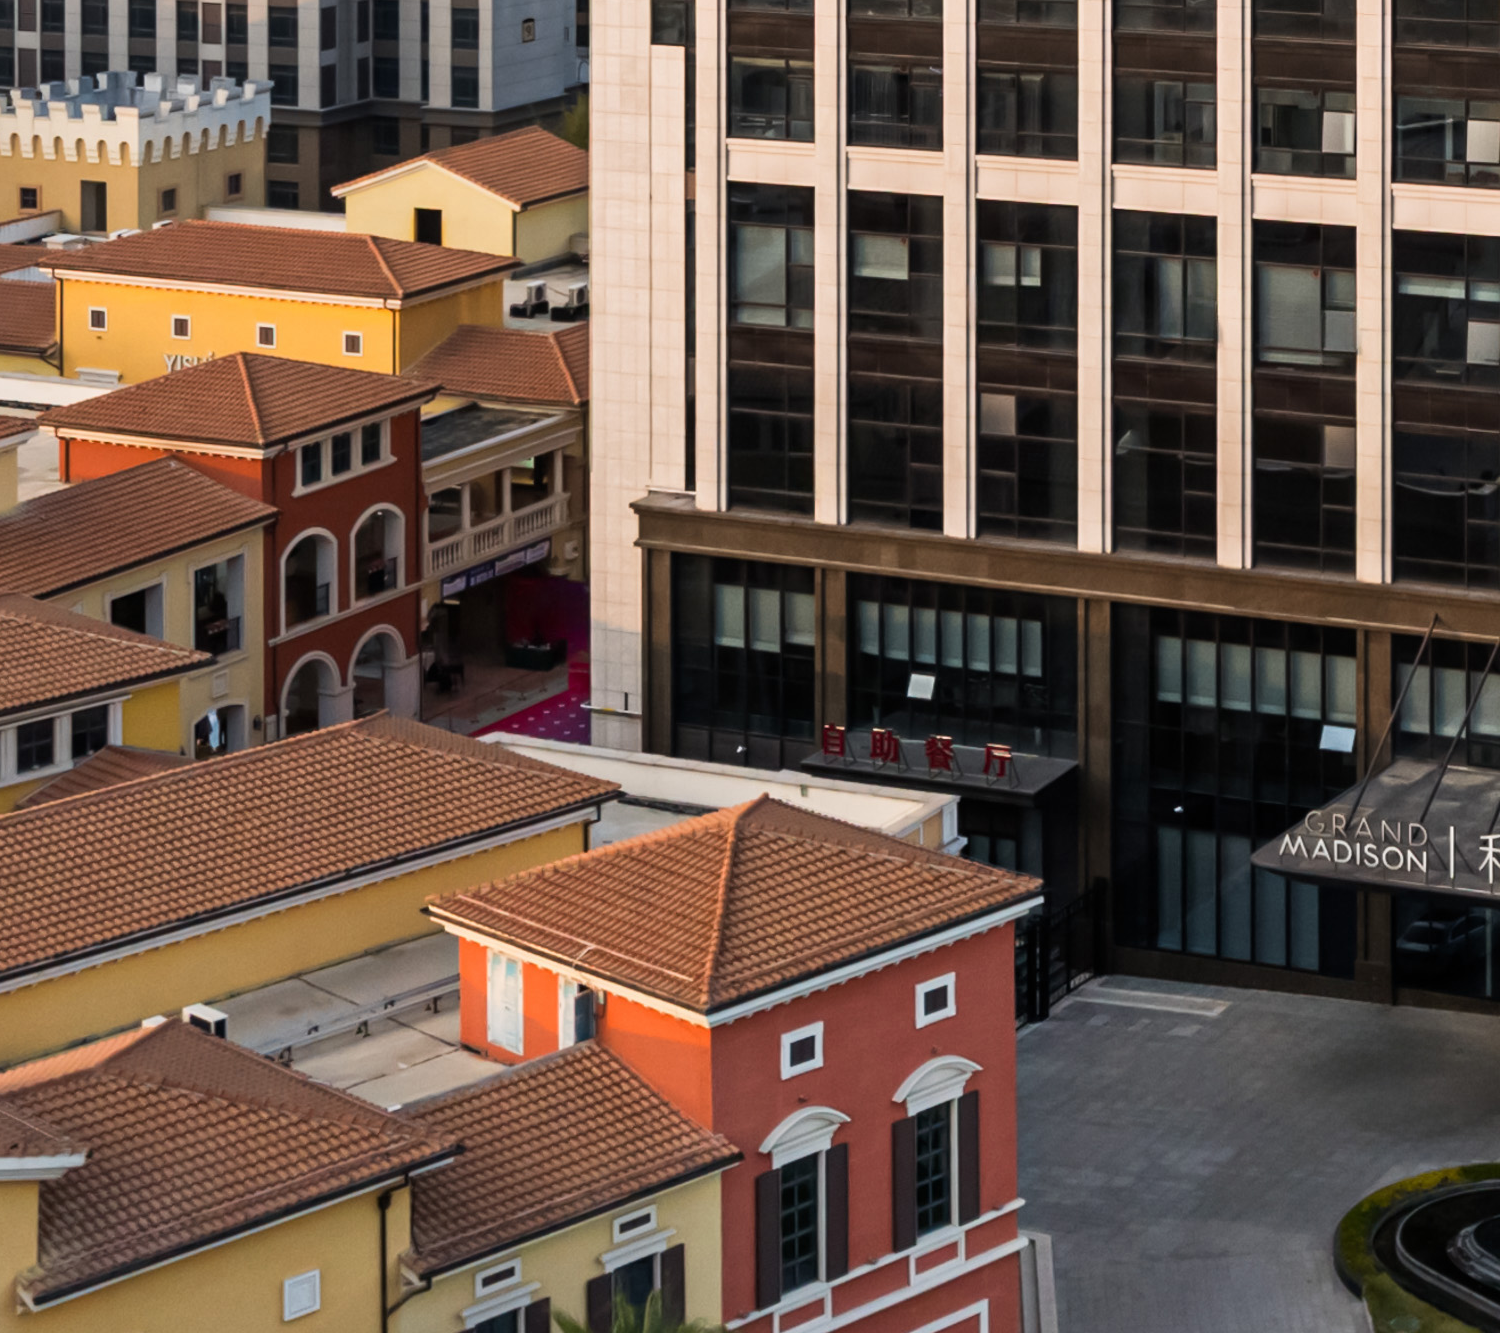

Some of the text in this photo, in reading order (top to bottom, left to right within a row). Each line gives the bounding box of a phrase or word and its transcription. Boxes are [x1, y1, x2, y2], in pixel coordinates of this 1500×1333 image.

[822, 722, 1013, 778] 自助餐厅
[1303, 809, 1428, 848] GRAND
[1278, 833, 1428, 874] MADISON
